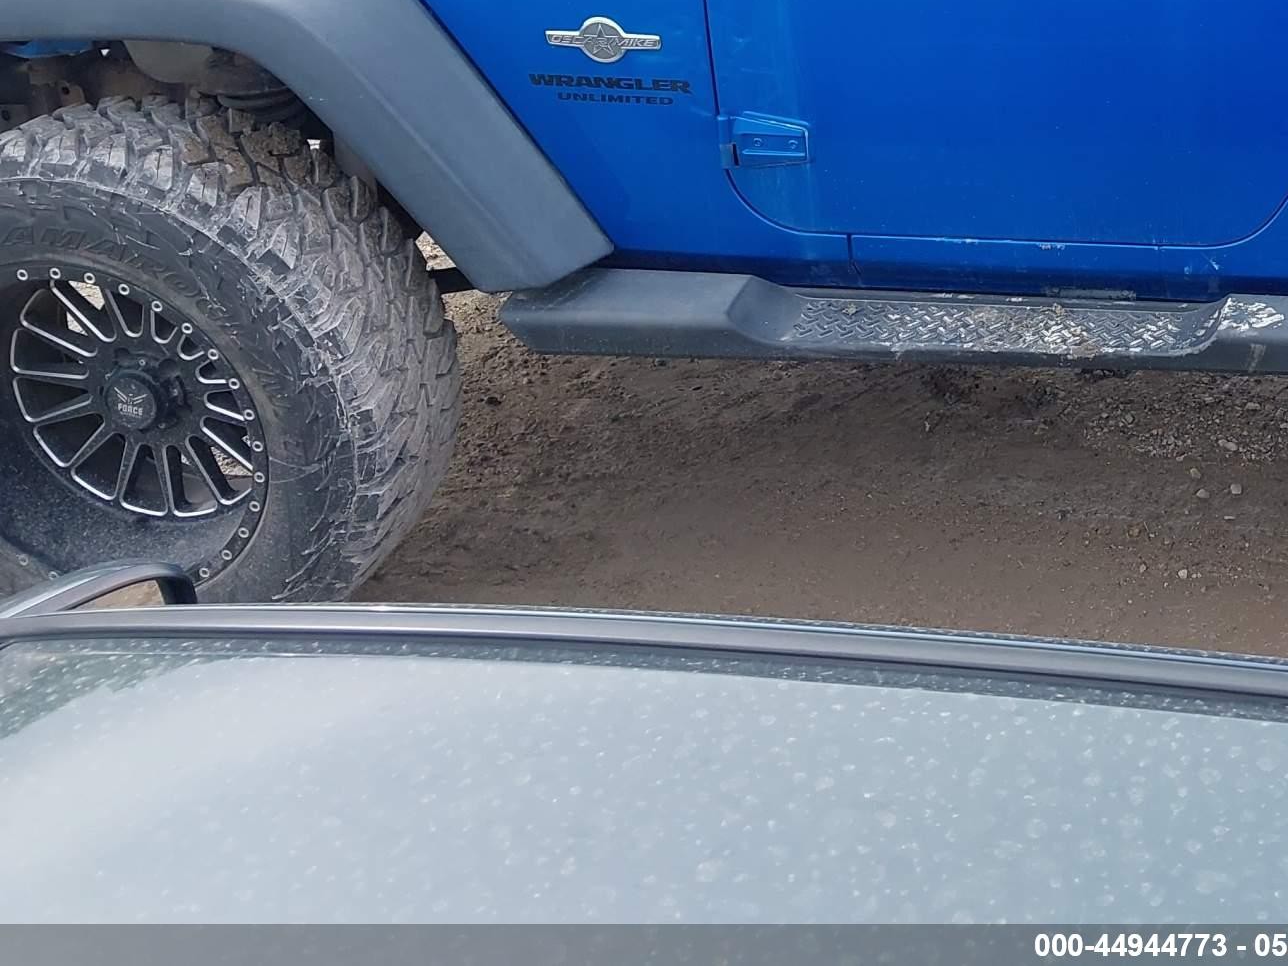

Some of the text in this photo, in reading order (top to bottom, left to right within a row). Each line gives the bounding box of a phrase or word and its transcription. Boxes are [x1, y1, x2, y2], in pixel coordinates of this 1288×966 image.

[614, 37, 656, 47] MIKE
[528, 73, 693, 95] WRANGLER
[557, 92, 675, 106] UNLIMITED
[117, 402, 144, 416] FORCE
